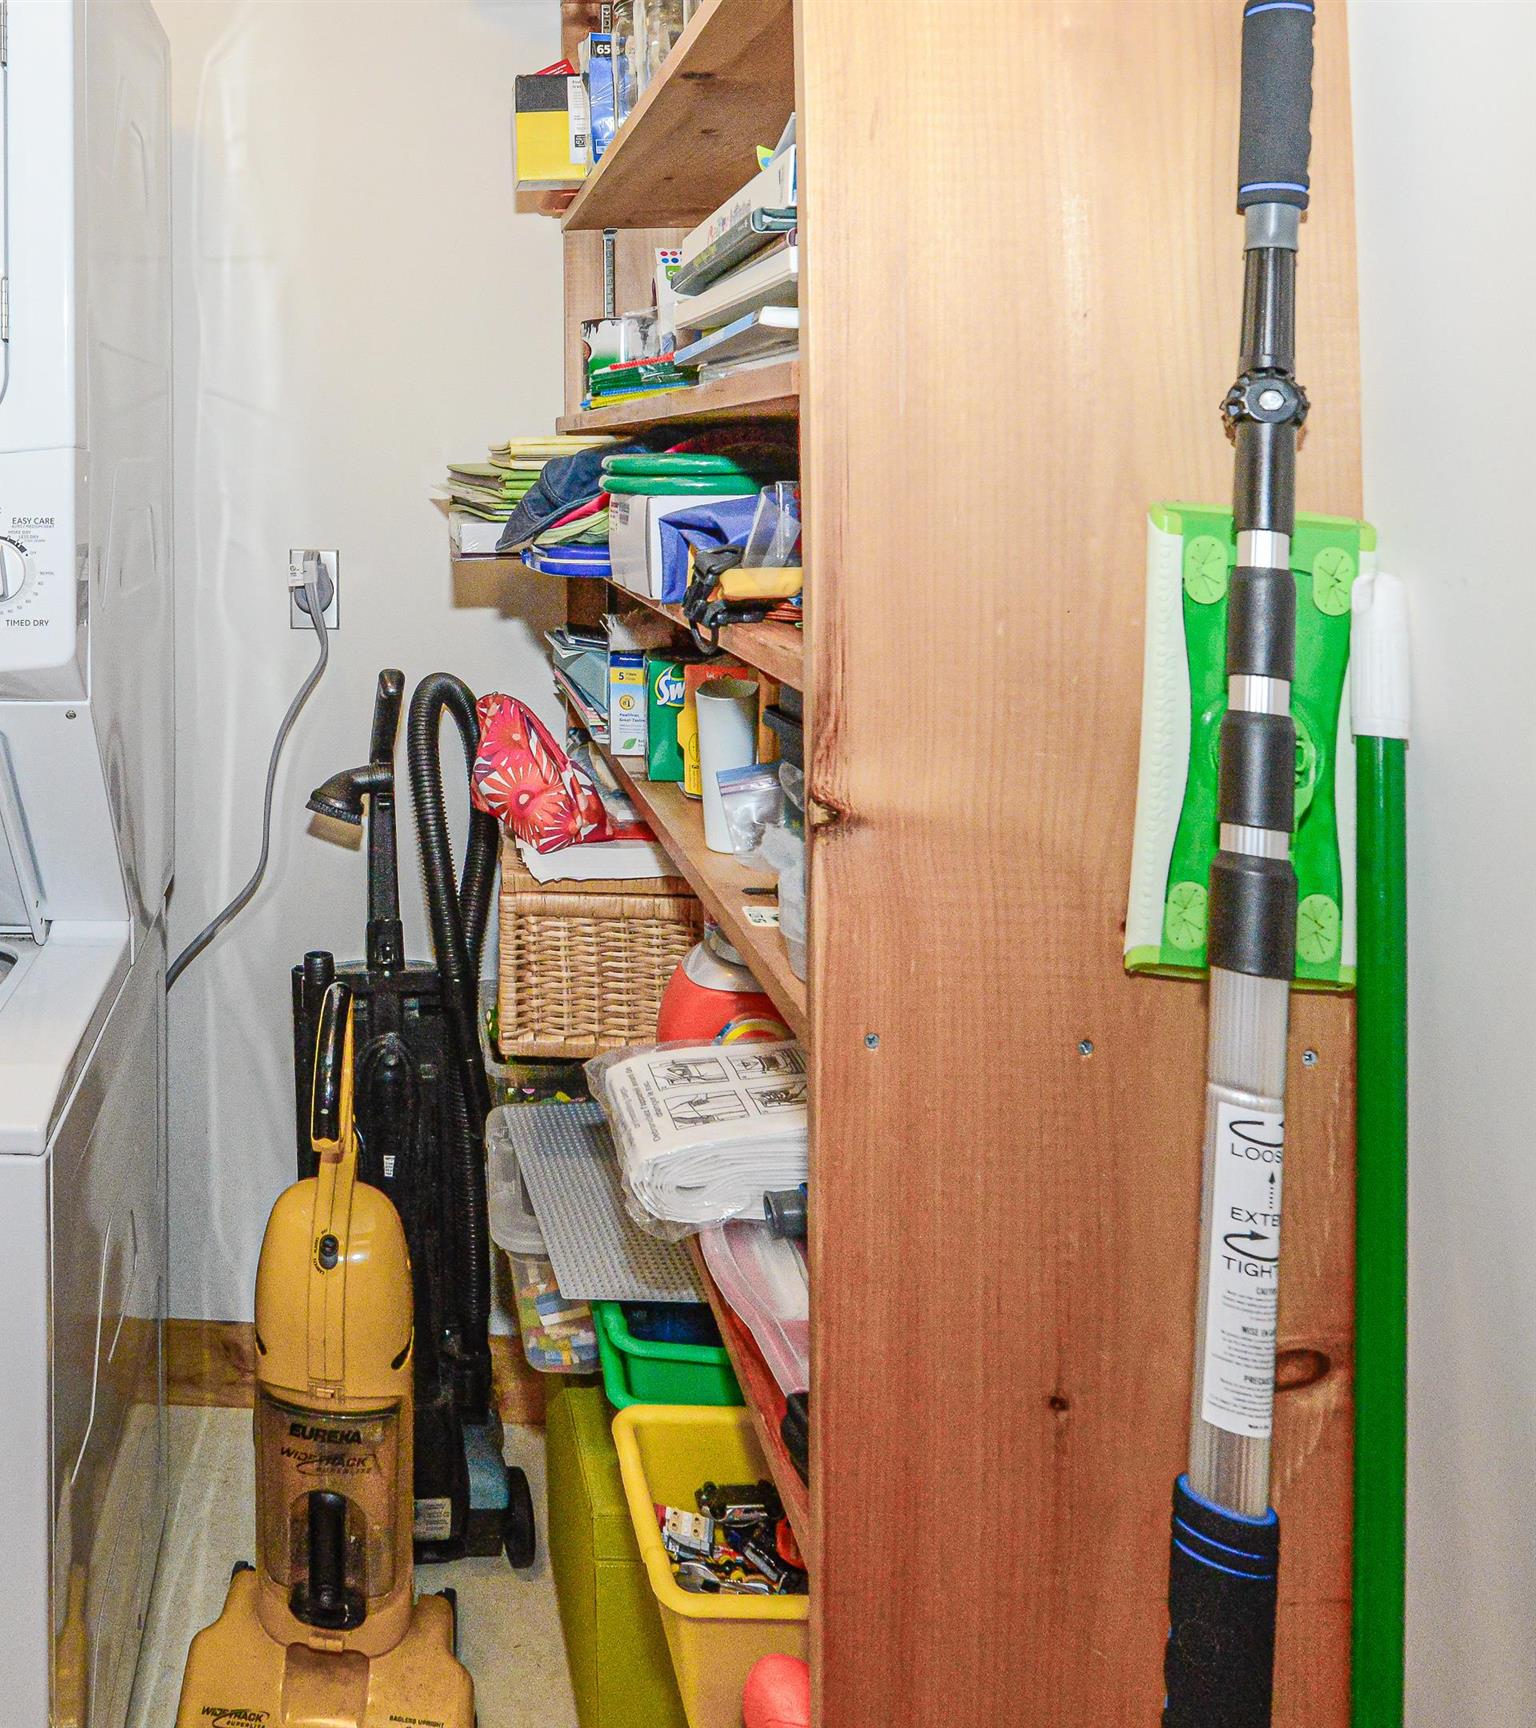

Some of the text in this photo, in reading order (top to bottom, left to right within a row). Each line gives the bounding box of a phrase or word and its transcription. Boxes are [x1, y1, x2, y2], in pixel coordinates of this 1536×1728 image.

[11, 517, 55, 525] EASY CARE
[4, 619, 50, 627] TIMED DRY
[618, 672, 624, 680] 5
[289, 1422, 362, 1444] EUREKA
